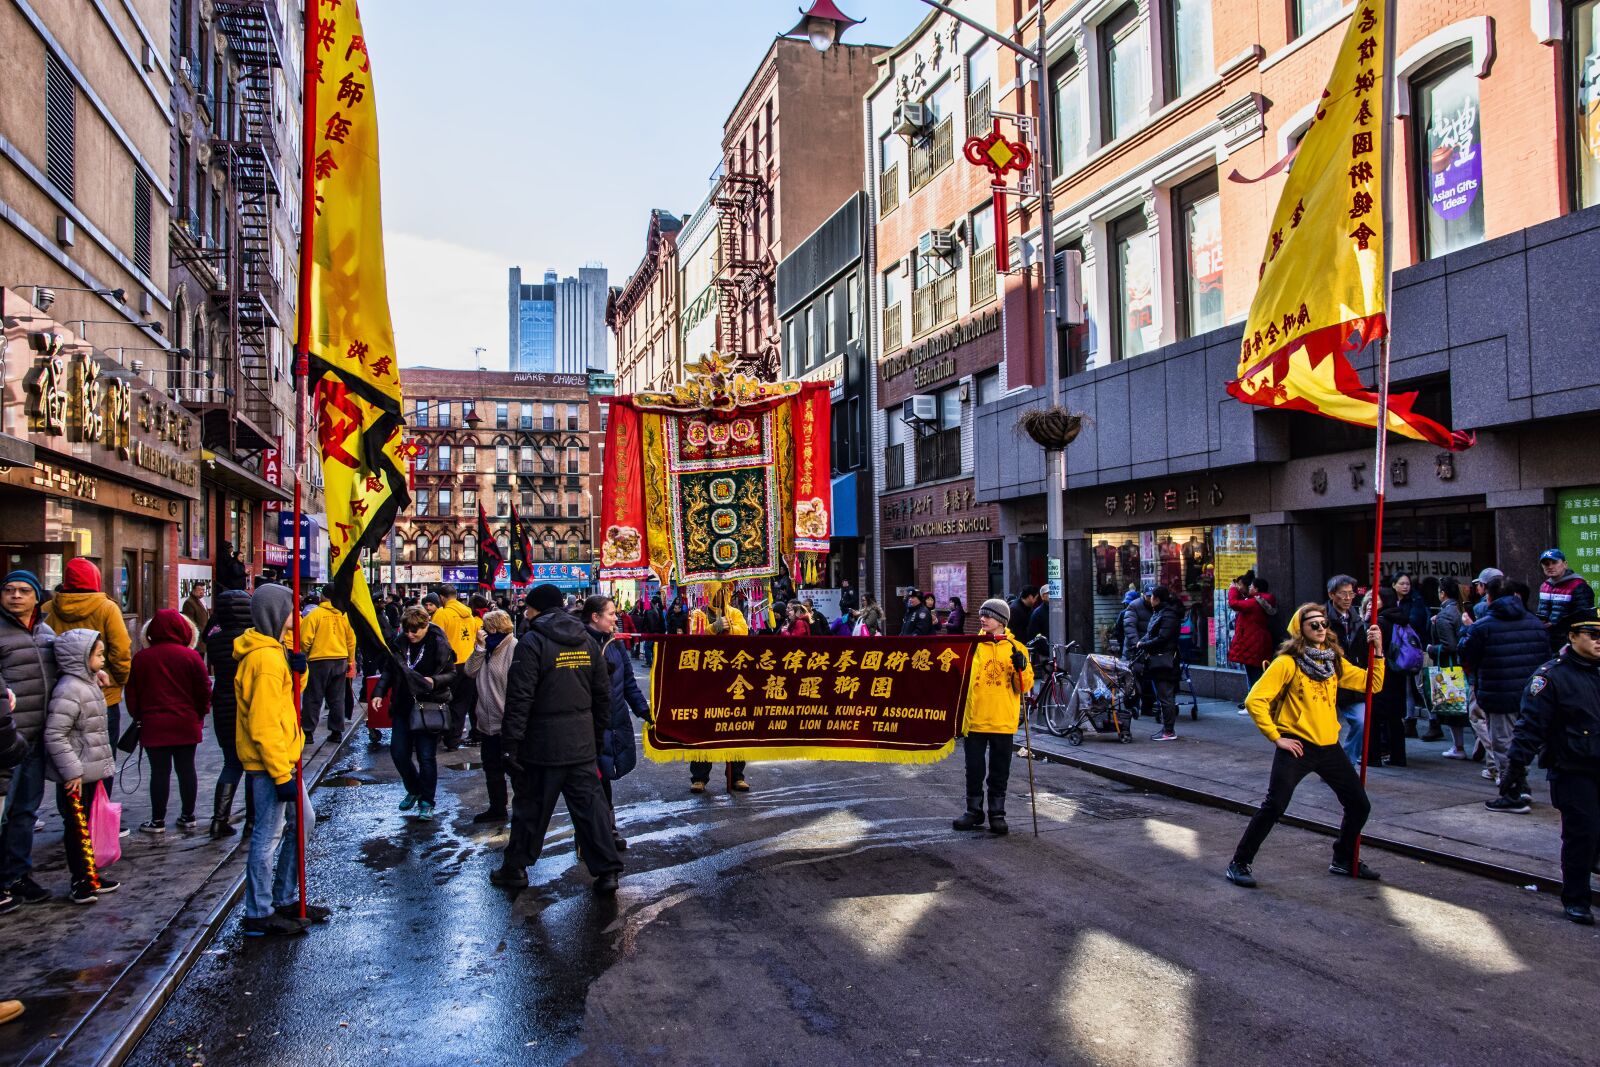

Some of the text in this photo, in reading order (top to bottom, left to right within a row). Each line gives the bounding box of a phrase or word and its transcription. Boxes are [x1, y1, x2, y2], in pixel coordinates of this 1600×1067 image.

[1432, 178, 1477, 203] Asian Gifts
[1442, 194, 1467, 211] Ideas
[905, 330, 951, 370] Consolidated
[952, 307, 1000, 350] Benevolent
[914, 356, 956, 390] Association
[927, 519, 957, 536] CHINESE
[958, 516, 992, 533] SCHOOL
[1580, 531, 1600, 545] 助行
[678, 647, 961, 674] 國際余志偉洪拳國術總會
[727, 674, 893, 700] 金龍醒獅團
[671, 707, 698, 721] YEE'S
[753, 705, 829, 717] INTERNATIONAL
[882, 706, 947, 722] ASSOCIATION
[714, 719, 899, 733] DRAGON AND LION DANCE TEAM
